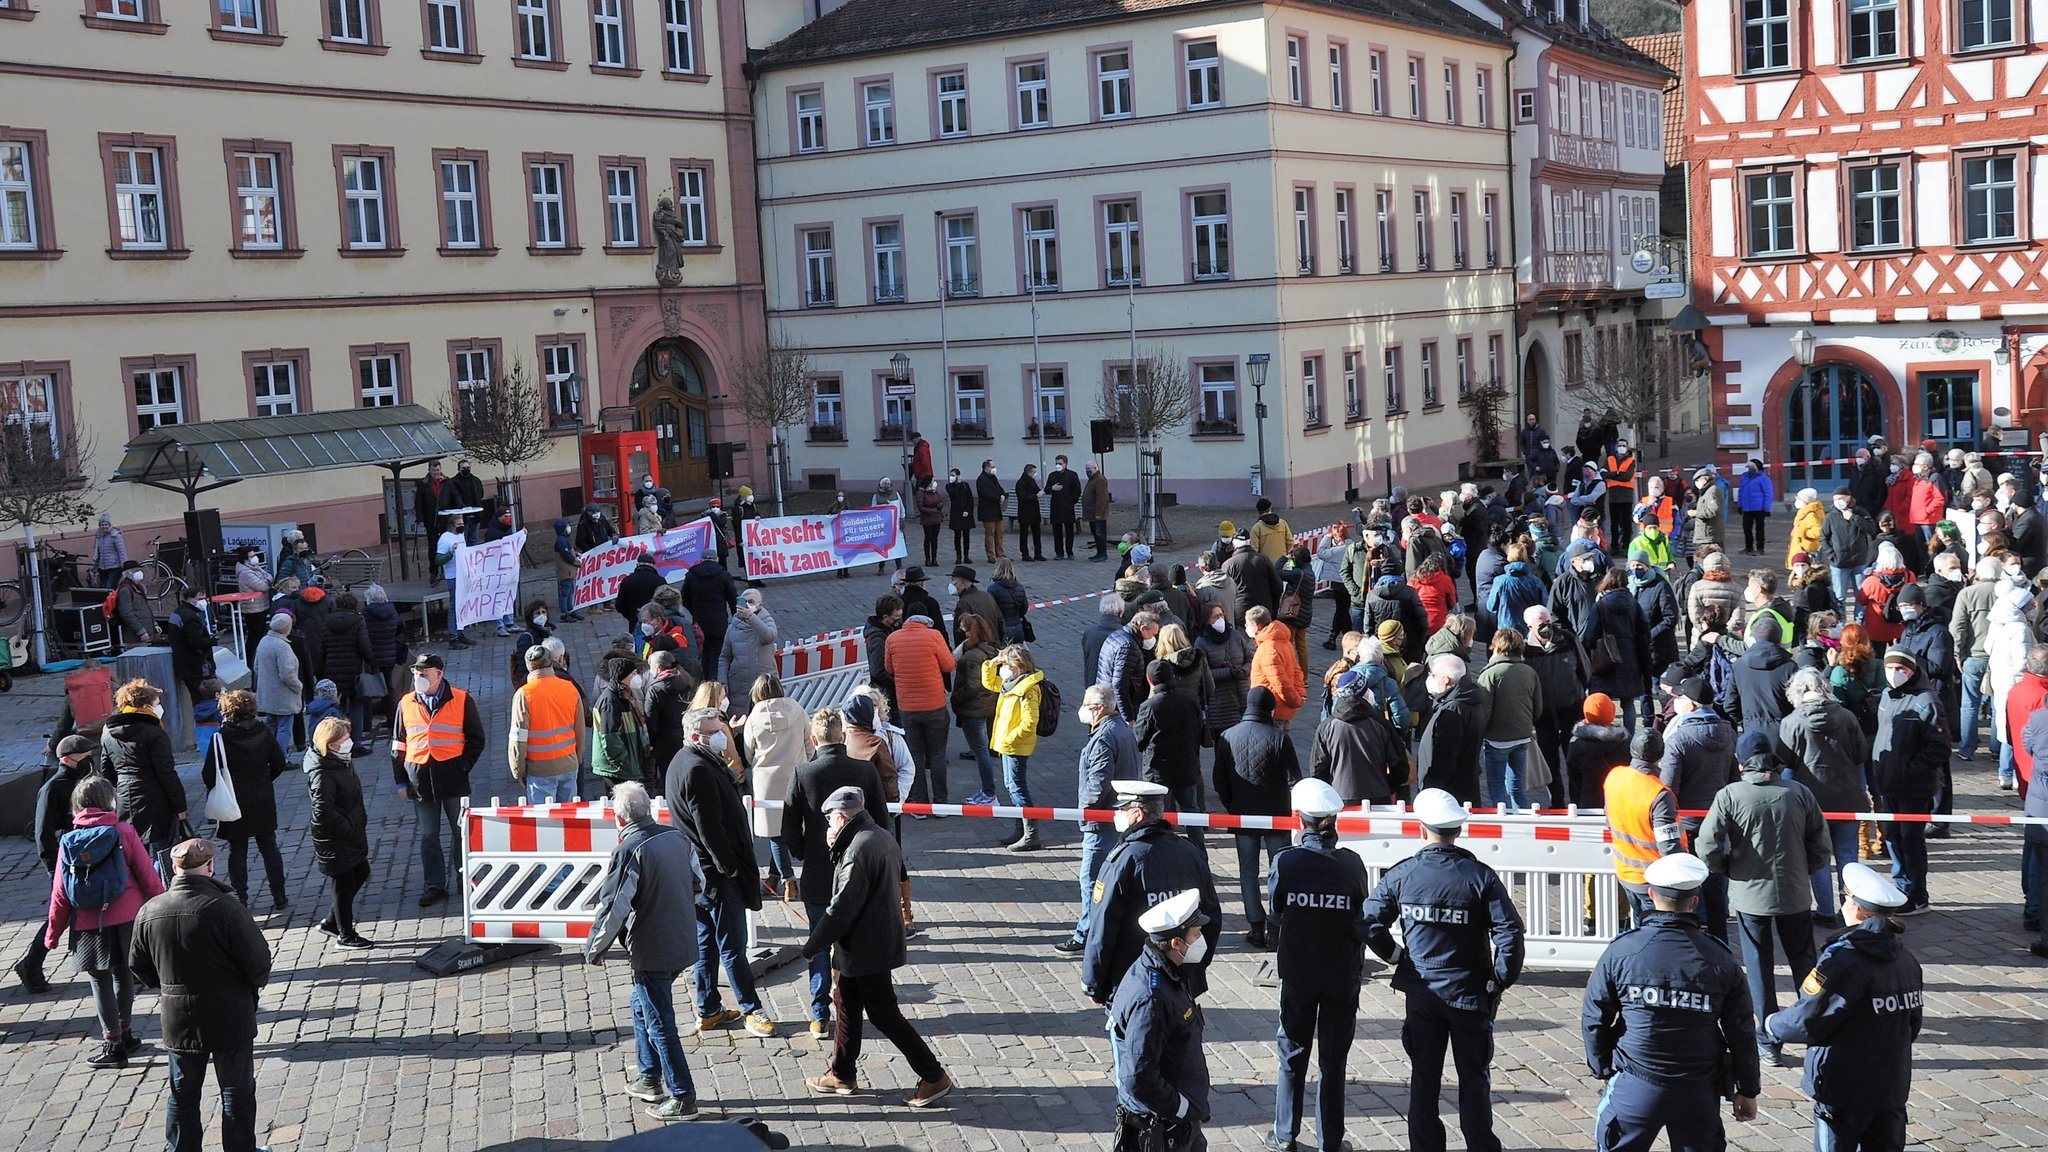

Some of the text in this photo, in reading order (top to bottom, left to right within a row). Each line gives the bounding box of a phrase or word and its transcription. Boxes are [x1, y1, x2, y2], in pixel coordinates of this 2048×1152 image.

[842, 515, 884, 527] Solidarisch.
[844, 523, 885, 535] Für unsere
[227, 536, 267, 546] Ladestation
[746, 519, 826, 547] Karscht
[845, 530, 887, 542] Demokratie.
[577, 541, 648, 579] Karscht
[747, 550, 838, 576] hält zam.
[574, 576, 606, 606] hält
[1286, 892, 1350, 909] POLIZEI
[1402, 903, 1469, 924] POLIZEI
[1628, 986, 1712, 1013] POLIZEI
[1872, 990, 1923, 1014] POLIZEI
